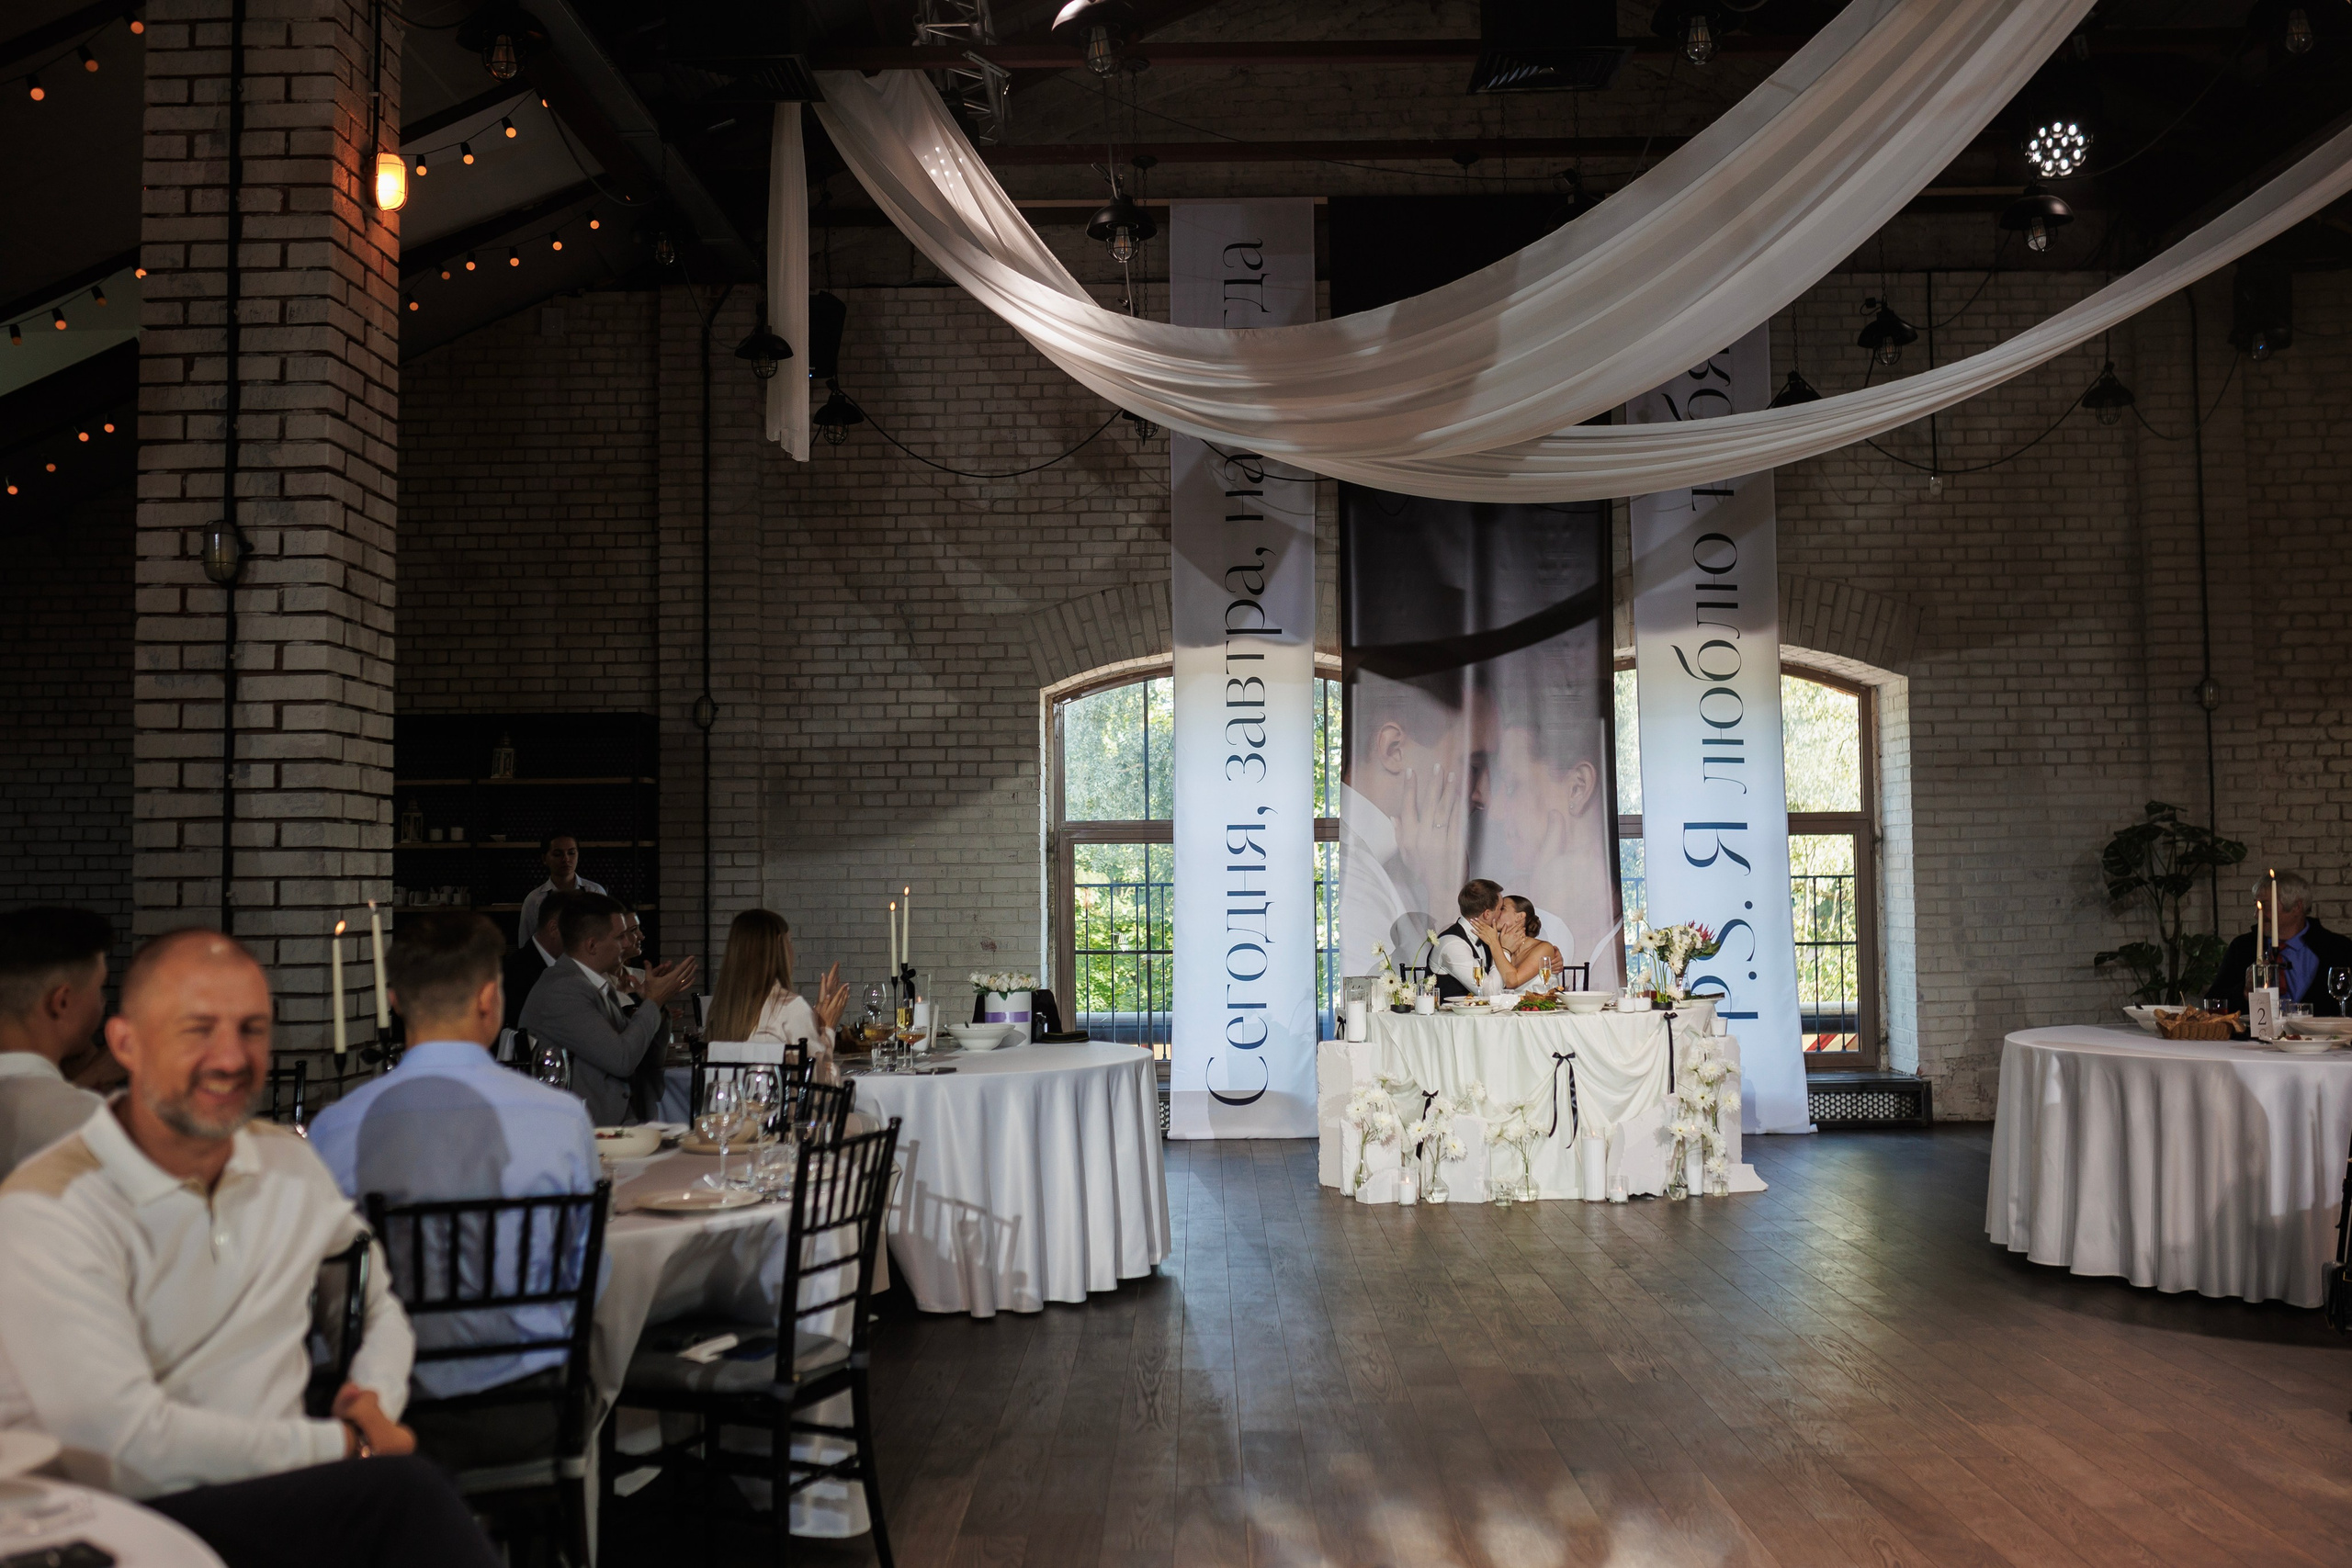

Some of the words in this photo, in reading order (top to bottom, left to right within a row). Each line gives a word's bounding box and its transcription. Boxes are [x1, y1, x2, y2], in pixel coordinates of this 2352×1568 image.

[1660, 347, 1735, 512] тбя
[1224, 547, 1283, 784] завтра,
[1670, 532, 1747, 795] люблю
[1682, 821, 1751, 876] Я
[1205, 806, 1279, 1107] Сегодня,
[2257, 1007, 2267, 1025] 2
